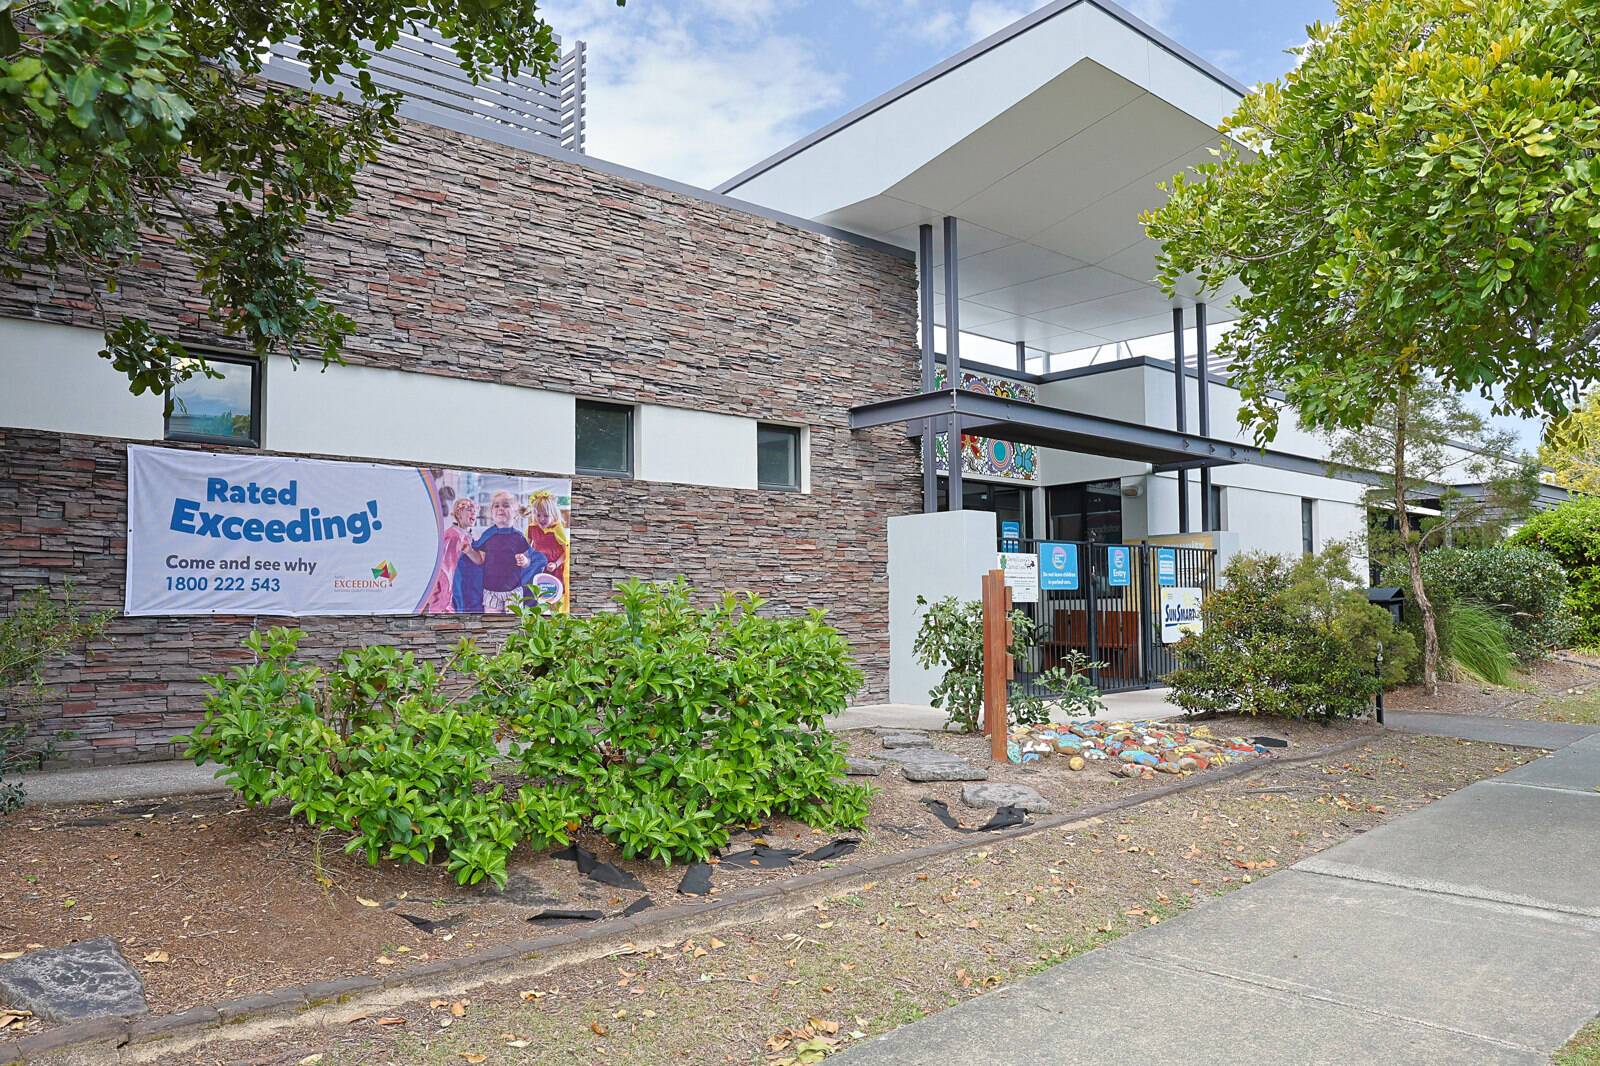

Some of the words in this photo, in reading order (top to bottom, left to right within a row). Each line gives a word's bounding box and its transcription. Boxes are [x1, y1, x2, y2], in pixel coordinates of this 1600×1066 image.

[207, 477, 297, 506] Rated
[169, 498, 383, 544] Exceeding!
[166, 555, 216, 570] Come
[220, 556, 251, 571] and
[254, 559, 281, 572] see
[284, 557, 317, 575] why
[166, 576, 208, 591] 1800
[214, 577, 245, 592] 222
[250, 577, 281, 592] 543
[334, 580, 388, 589] EXCEEDING
